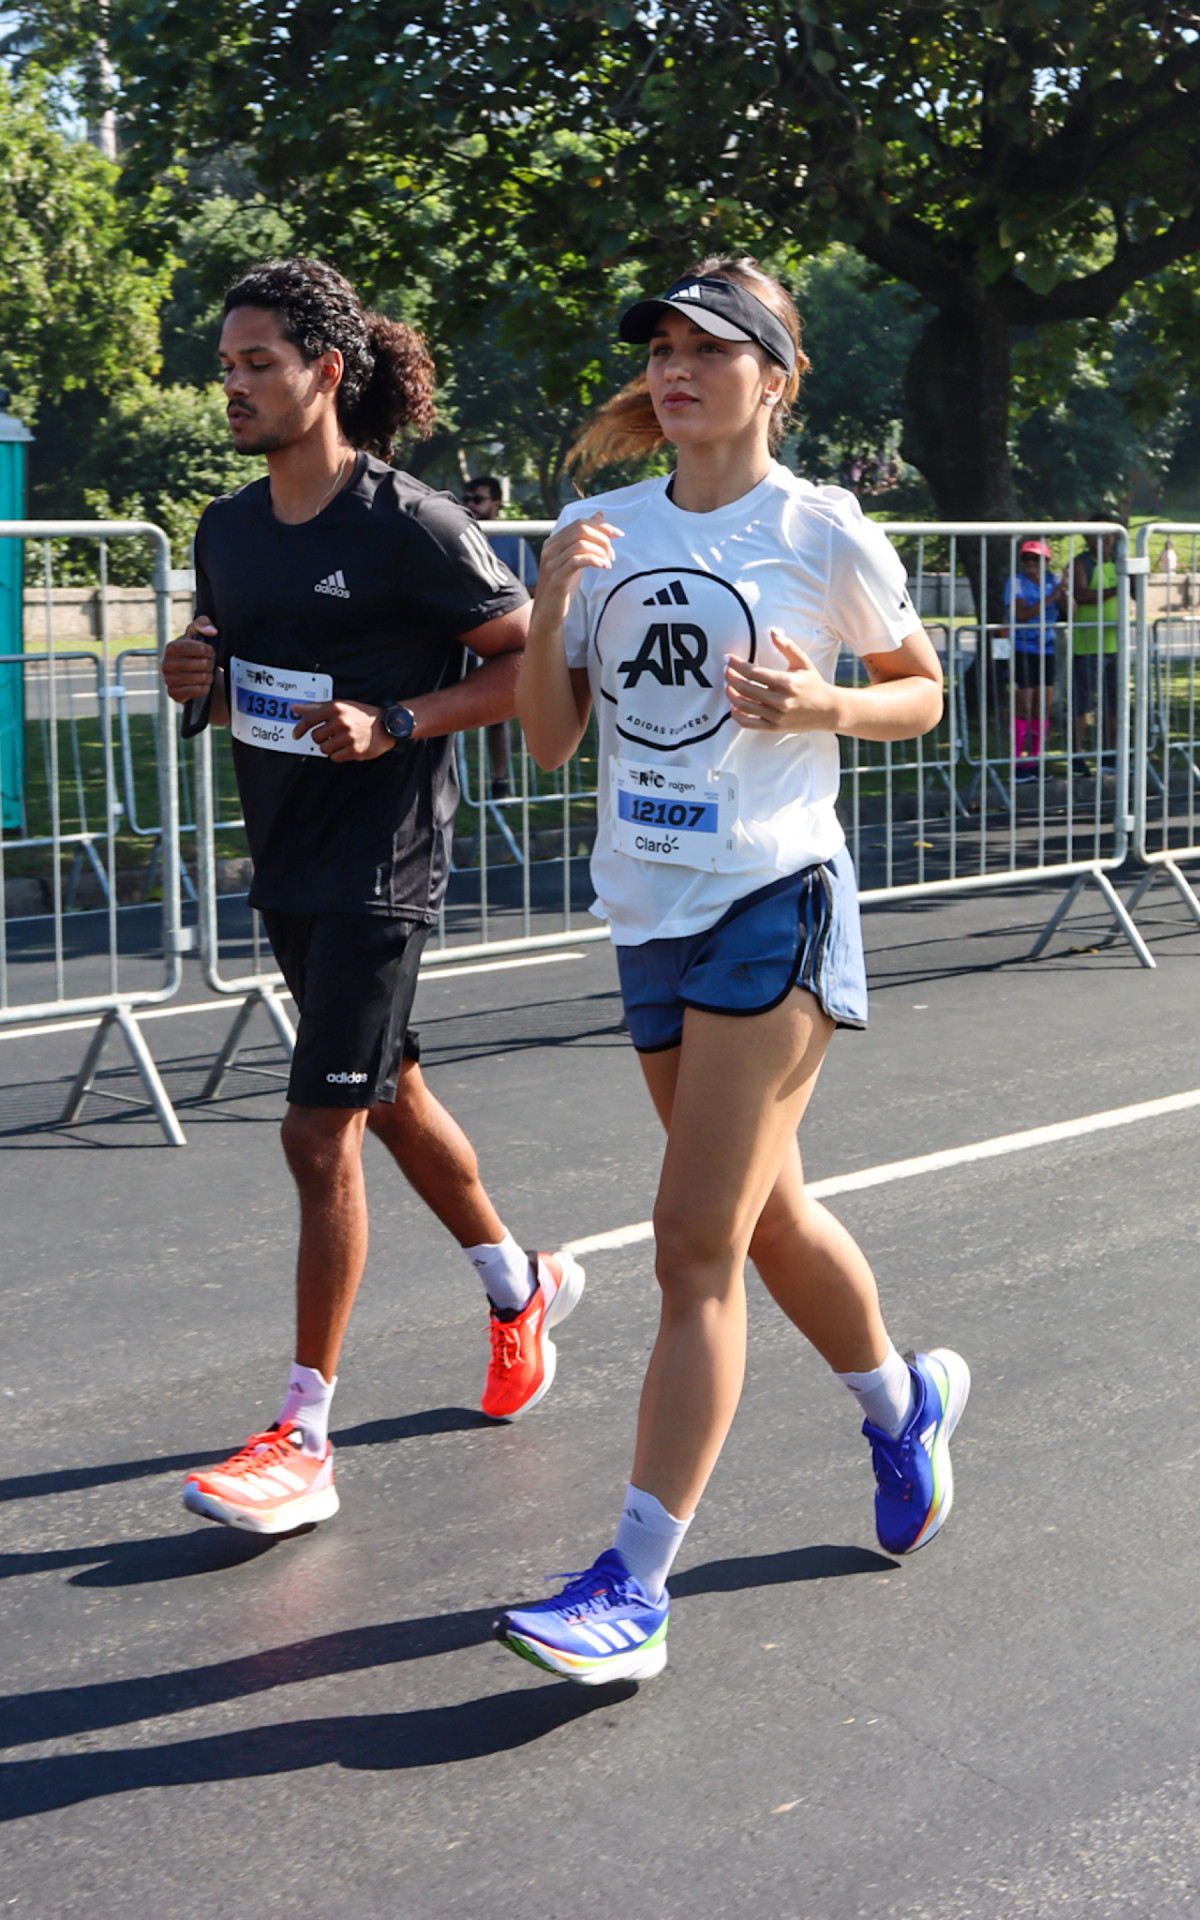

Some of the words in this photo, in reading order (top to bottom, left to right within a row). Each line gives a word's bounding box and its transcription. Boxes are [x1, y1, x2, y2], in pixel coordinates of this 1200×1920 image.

[314, 583, 350, 599] adidas
[617, 623, 713, 689] AR
[251, 725, 280, 742] Claro
[626, 715, 666, 735] ADIDAS
[631, 799, 706, 828] 12107
[635, 836, 672, 854] Claro
[326, 1071, 368, 1084] adidas
